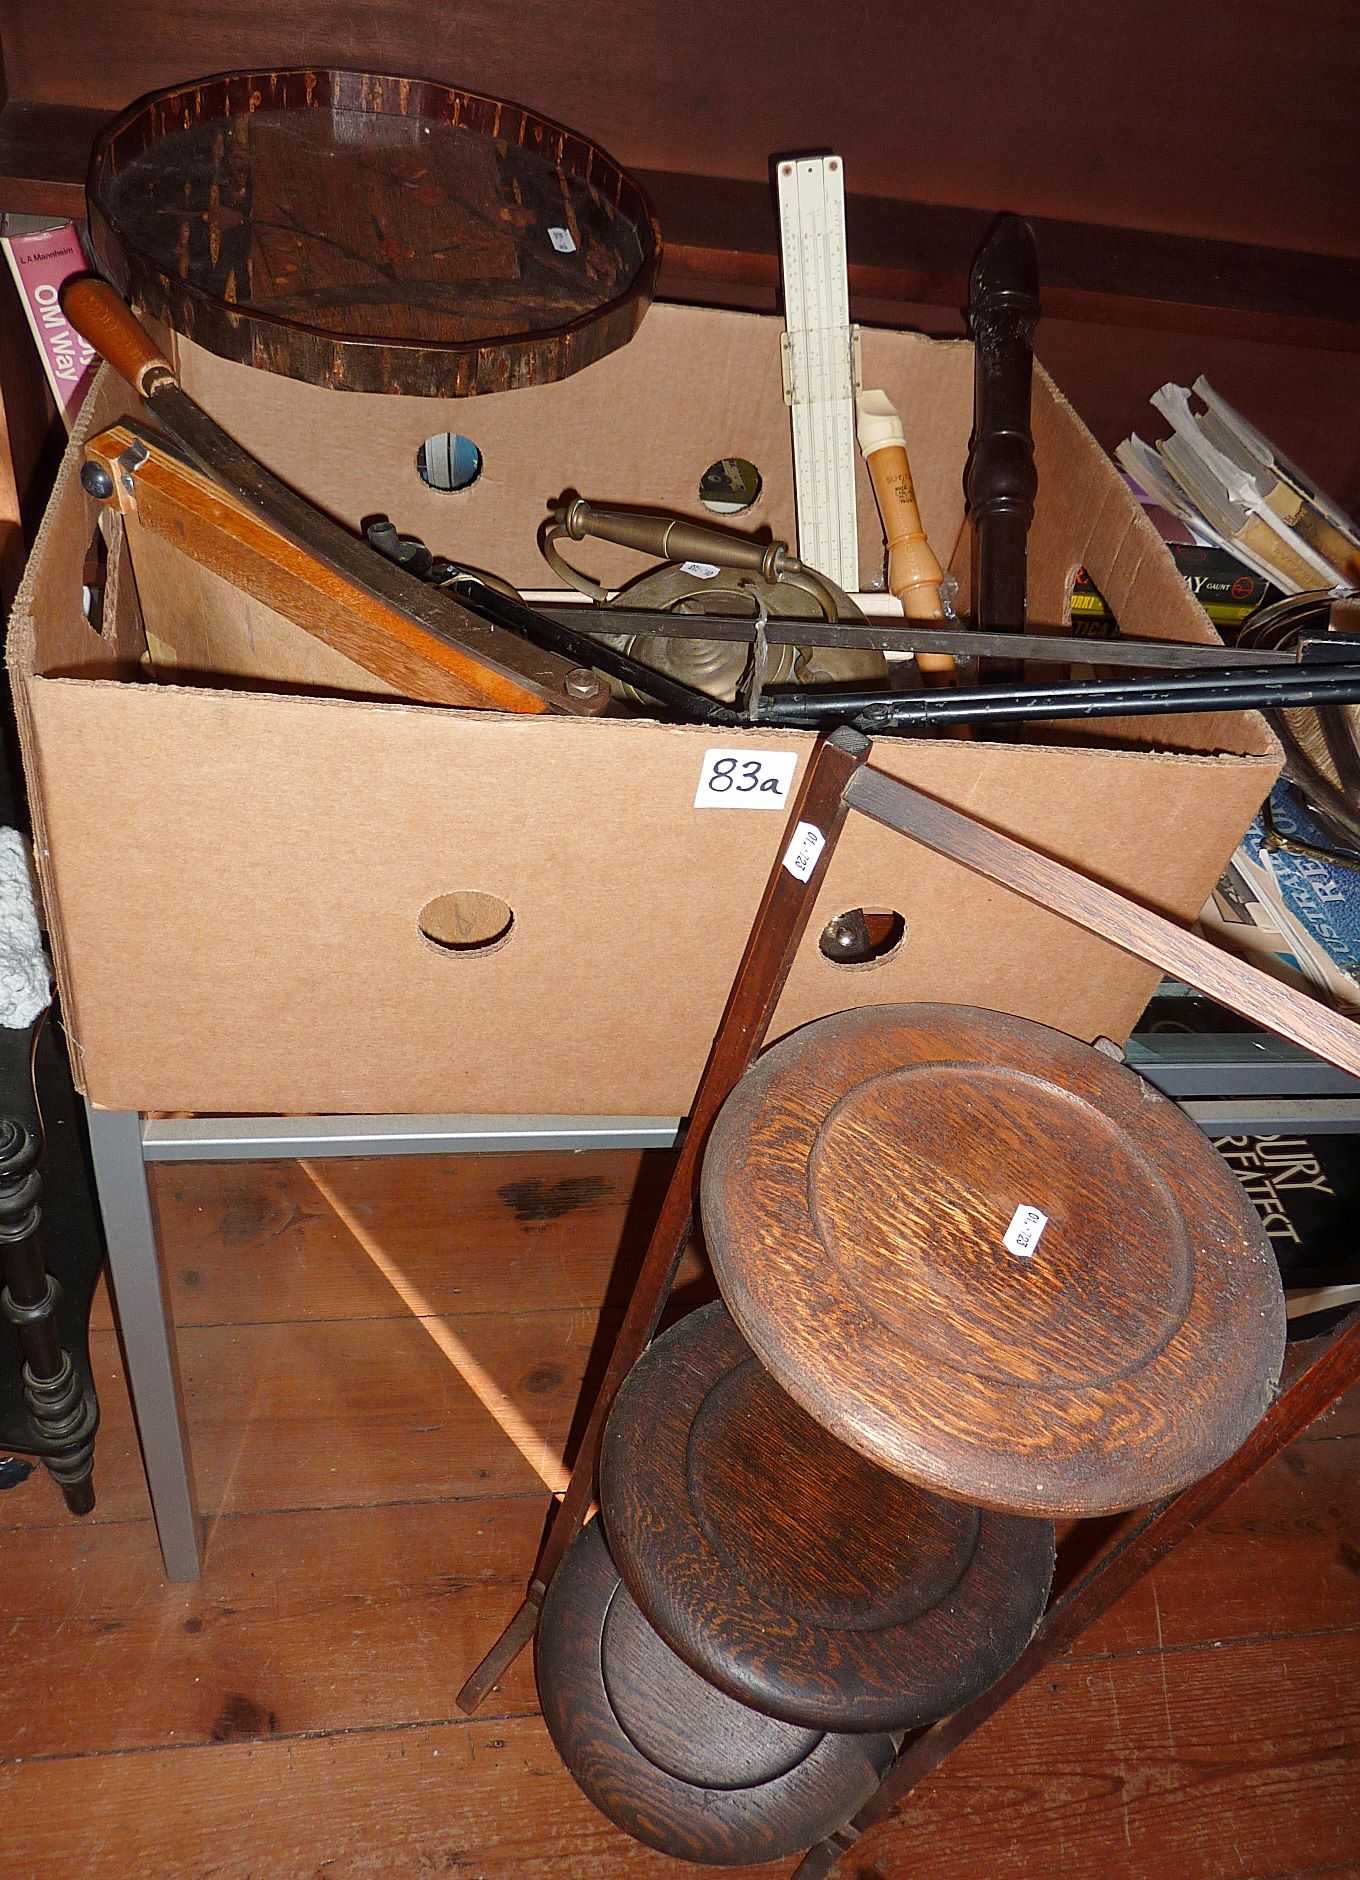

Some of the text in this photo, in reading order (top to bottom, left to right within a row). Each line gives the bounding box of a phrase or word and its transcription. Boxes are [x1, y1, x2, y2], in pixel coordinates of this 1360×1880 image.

[20, 247, 74, 264] L A Mannheim
[34, 285, 80, 382] OM Way
[1206, 582, 1231, 592] GAUNT
[708, 757, 783, 795] 83a
